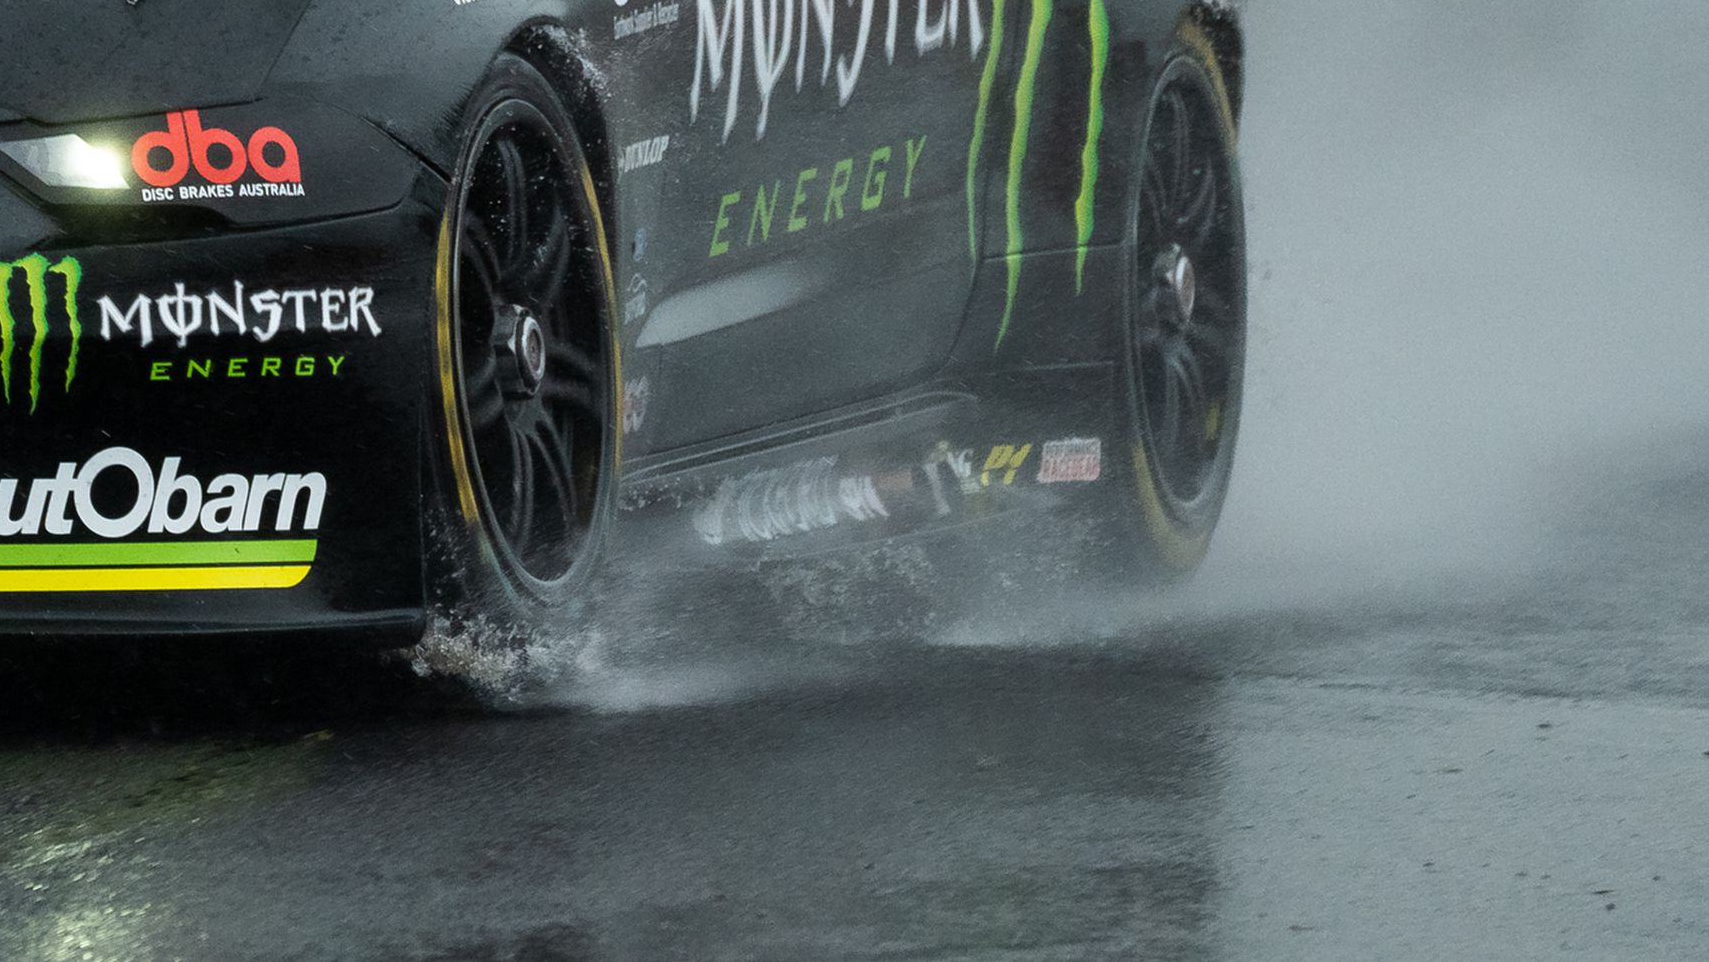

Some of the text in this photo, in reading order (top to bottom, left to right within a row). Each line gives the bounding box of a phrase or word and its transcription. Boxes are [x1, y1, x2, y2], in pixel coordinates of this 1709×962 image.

[130, 109, 303, 187] dba
[142, 182, 306, 202] DISC BRAKES AUSTRALIA
[709, 134, 928, 258] ENERGY
[149, 355, 347, 381] ENERGY
